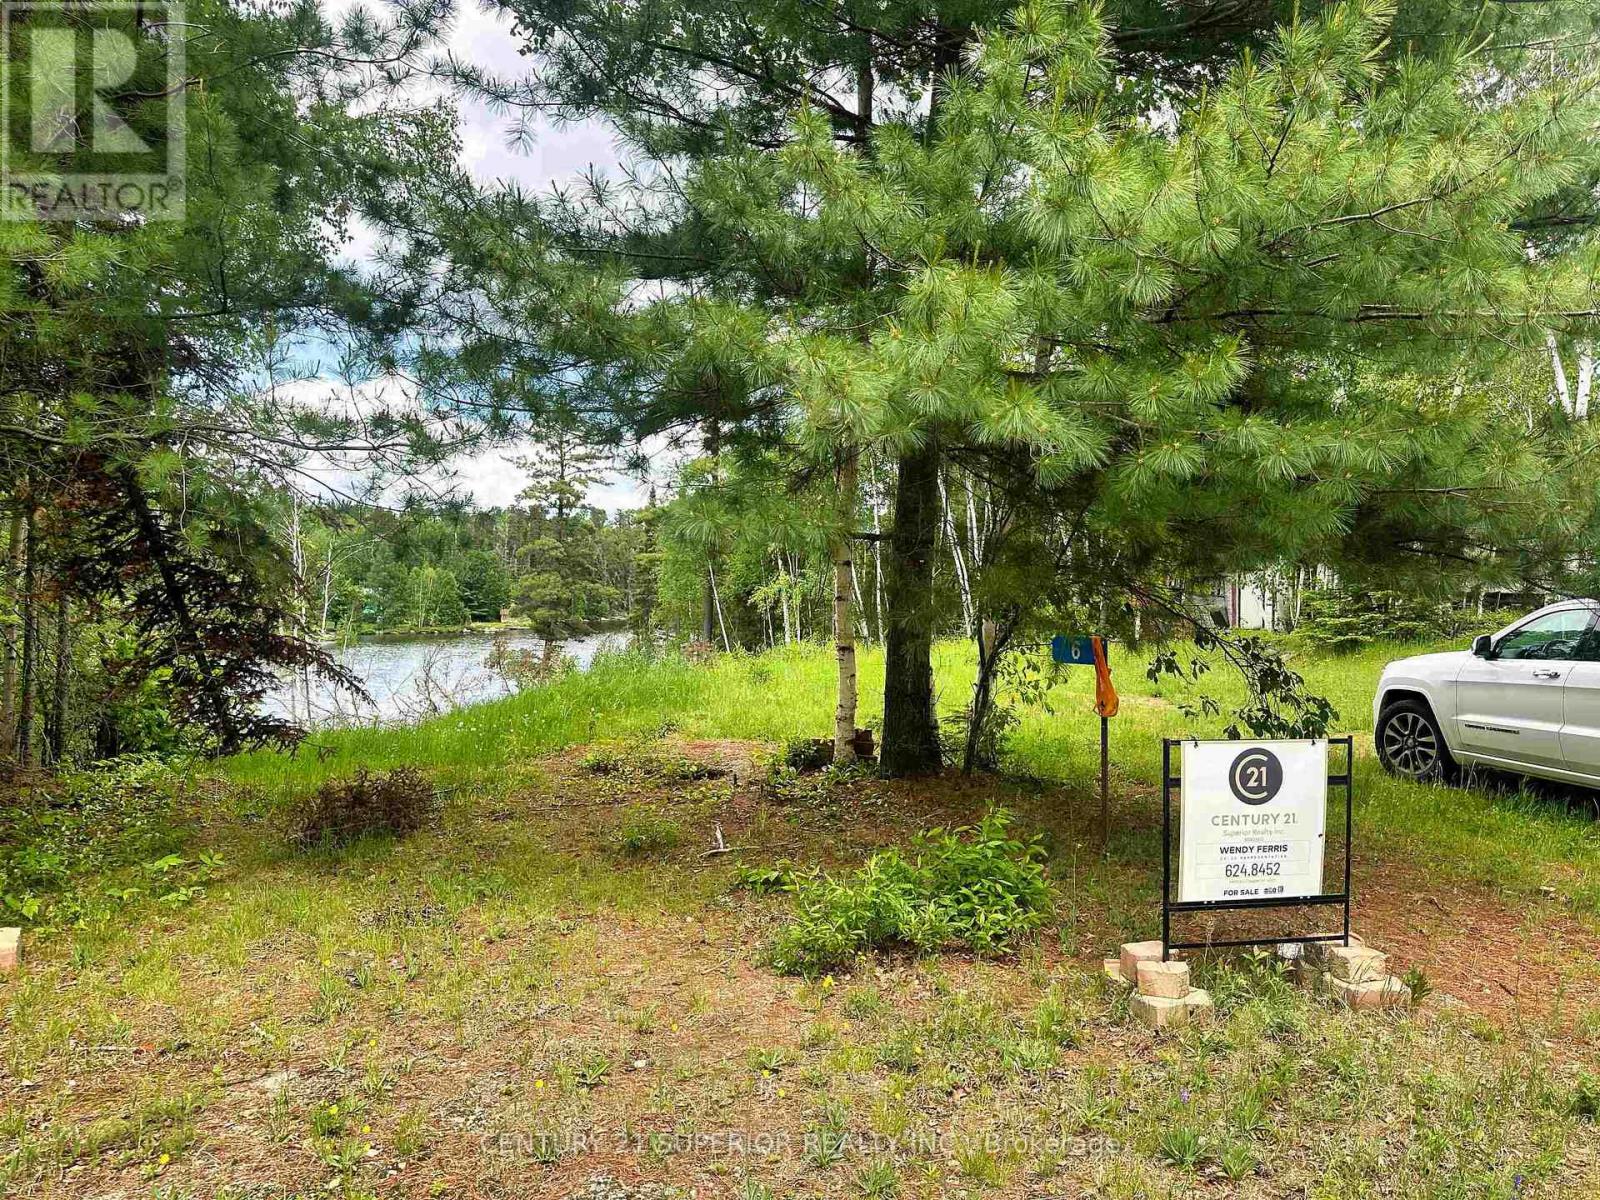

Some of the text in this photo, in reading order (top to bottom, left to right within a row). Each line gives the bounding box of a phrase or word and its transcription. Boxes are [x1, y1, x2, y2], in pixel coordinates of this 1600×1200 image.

[1211, 813, 1280, 827] CENTURY
[1219, 844, 1289, 855] WENDY FERRIS
[1225, 862, 1281, 878] 624.8452
[1223, 889, 1239, 897] FOR
[1240, 888, 1260, 896] SALE
